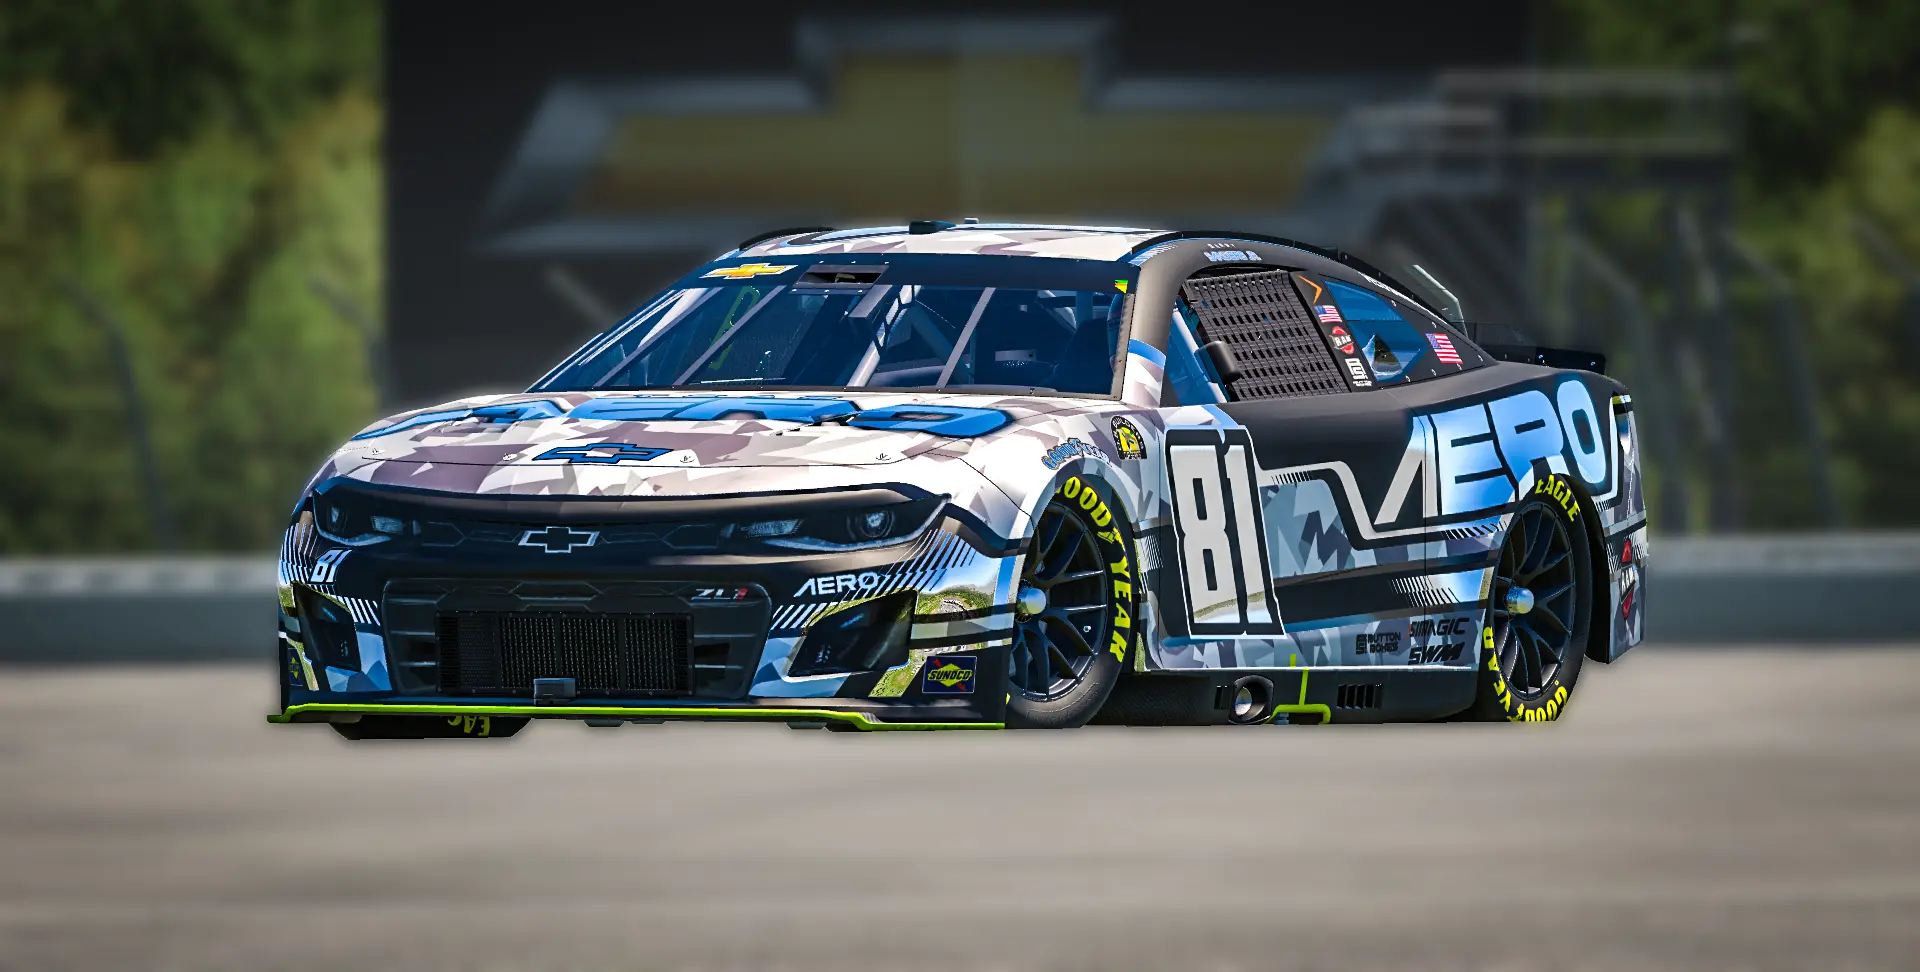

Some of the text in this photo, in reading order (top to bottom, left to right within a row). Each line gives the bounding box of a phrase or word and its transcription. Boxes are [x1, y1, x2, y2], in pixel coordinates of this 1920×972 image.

[1374, 378, 1604, 525] AERO
[1056, 476, 1112, 527] OOD
[1168, 435, 1277, 630] 81
[308, 549, 353, 584] 81
[793, 571, 879, 598] AERO
[928, 669, 973, 682] SUNOCO
